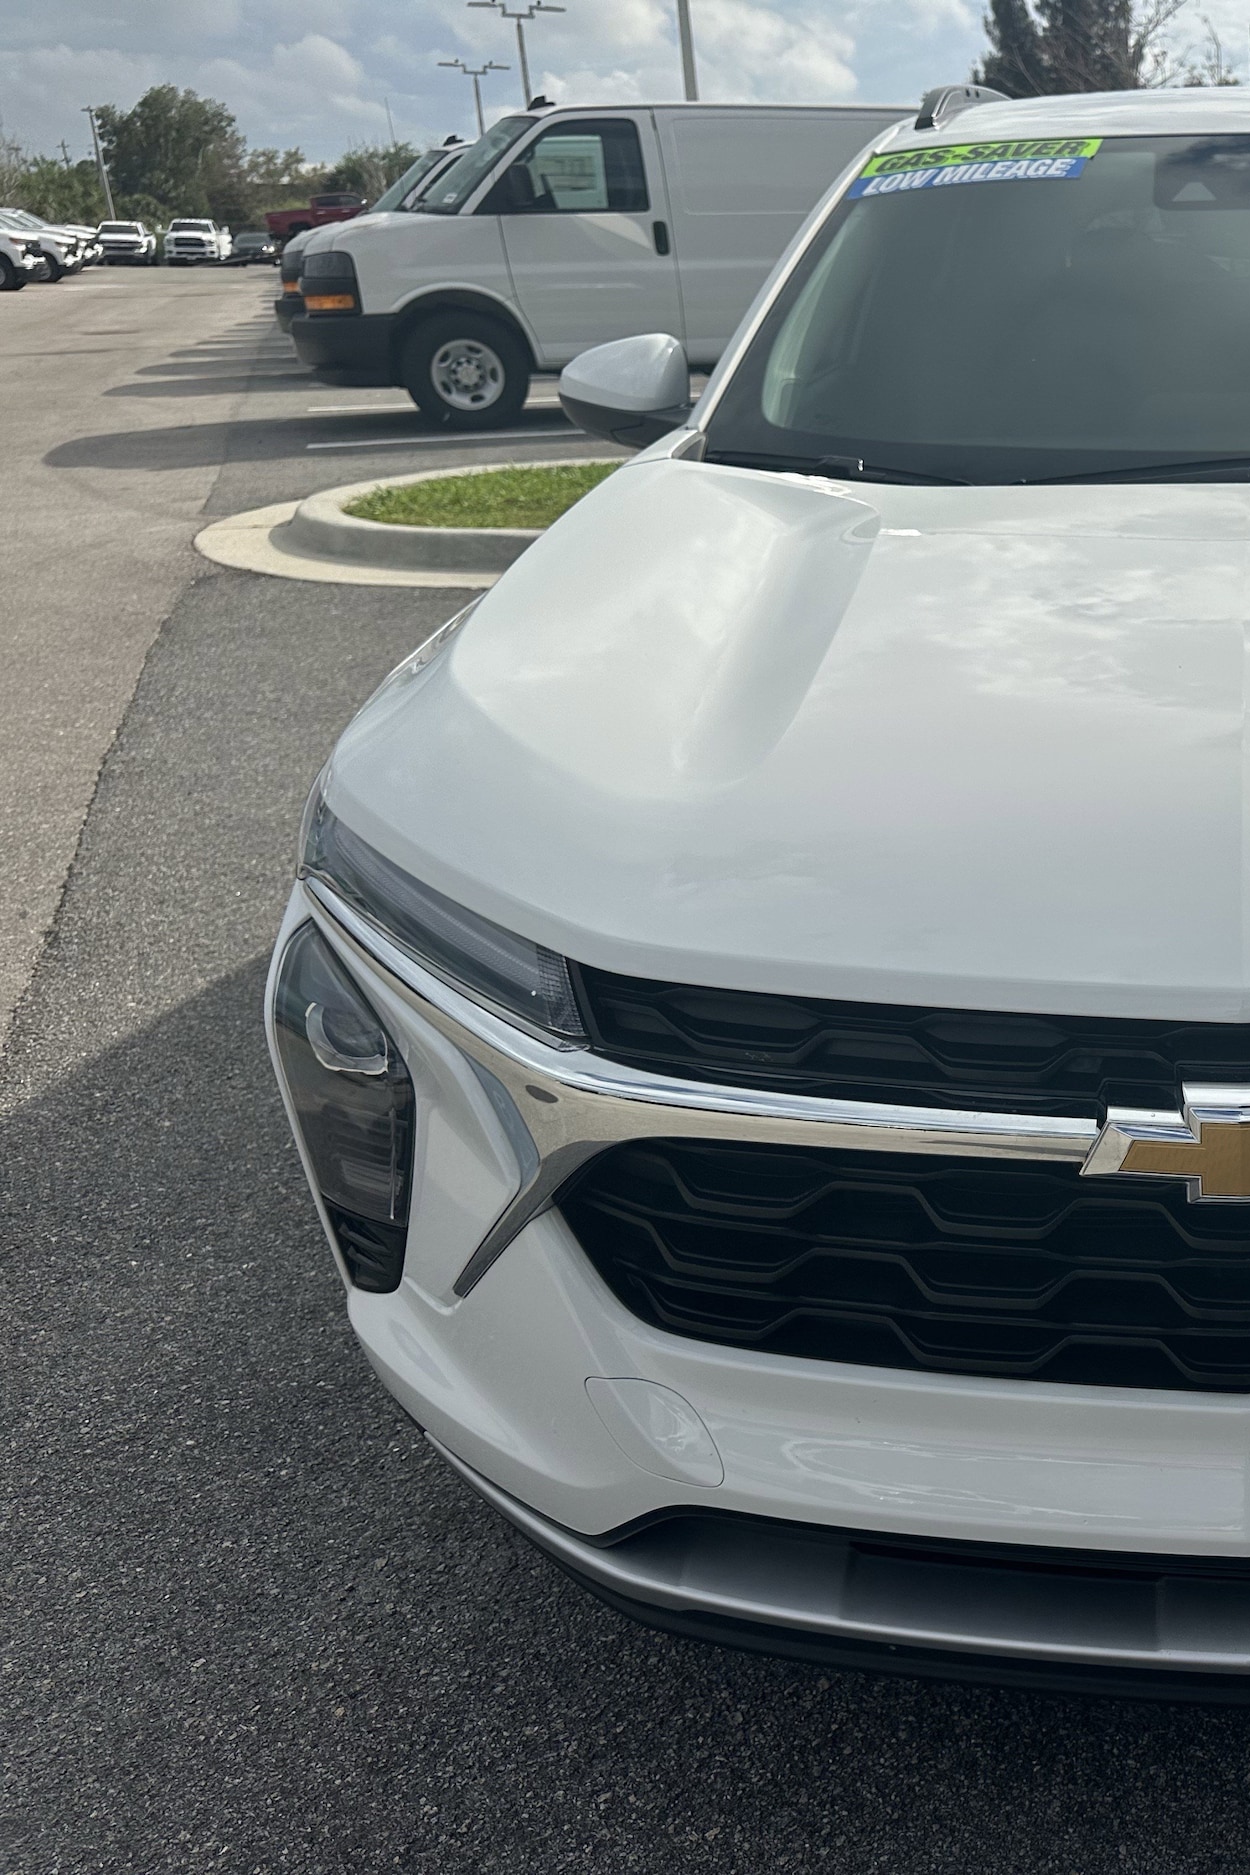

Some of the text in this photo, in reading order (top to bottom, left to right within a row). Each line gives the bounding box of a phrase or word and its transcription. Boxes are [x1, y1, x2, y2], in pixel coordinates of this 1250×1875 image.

[875, 141, 1089, 173] GAS-SAVER
[862, 158, 1076, 196] LOW MILEAGE
